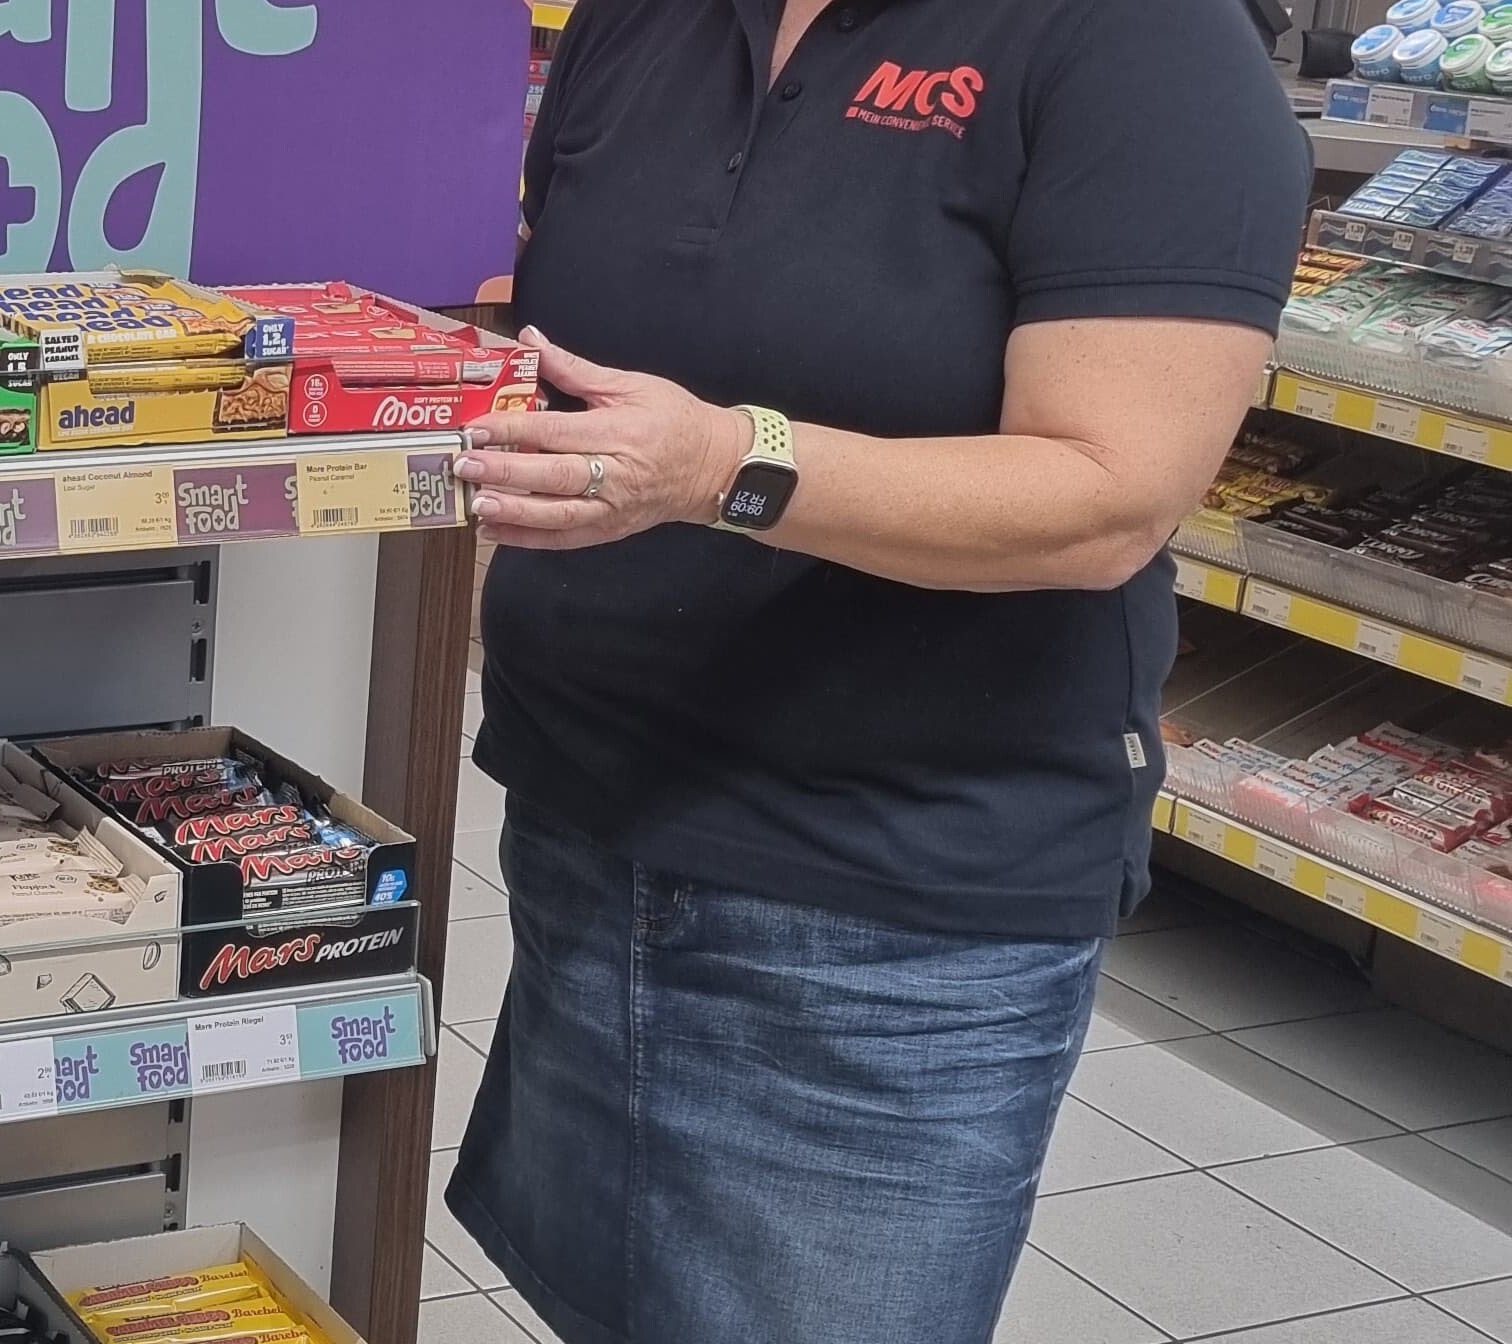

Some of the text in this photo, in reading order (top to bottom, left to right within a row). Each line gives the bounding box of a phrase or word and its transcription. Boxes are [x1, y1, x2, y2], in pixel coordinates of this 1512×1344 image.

[853, 61, 984, 118] MCS
[931, 114, 967, 140] SERVICE
[44, 334, 79, 345] SALTED
[44, 343, 79, 355] PEANUT
[44, 353, 80, 363] CARAMEL
[59, 400, 136, 429] ahead
[371, 395, 453, 427] More
[175, 804, 300, 845] Mars
[199, 927, 404, 990] Mars PROTEIN
